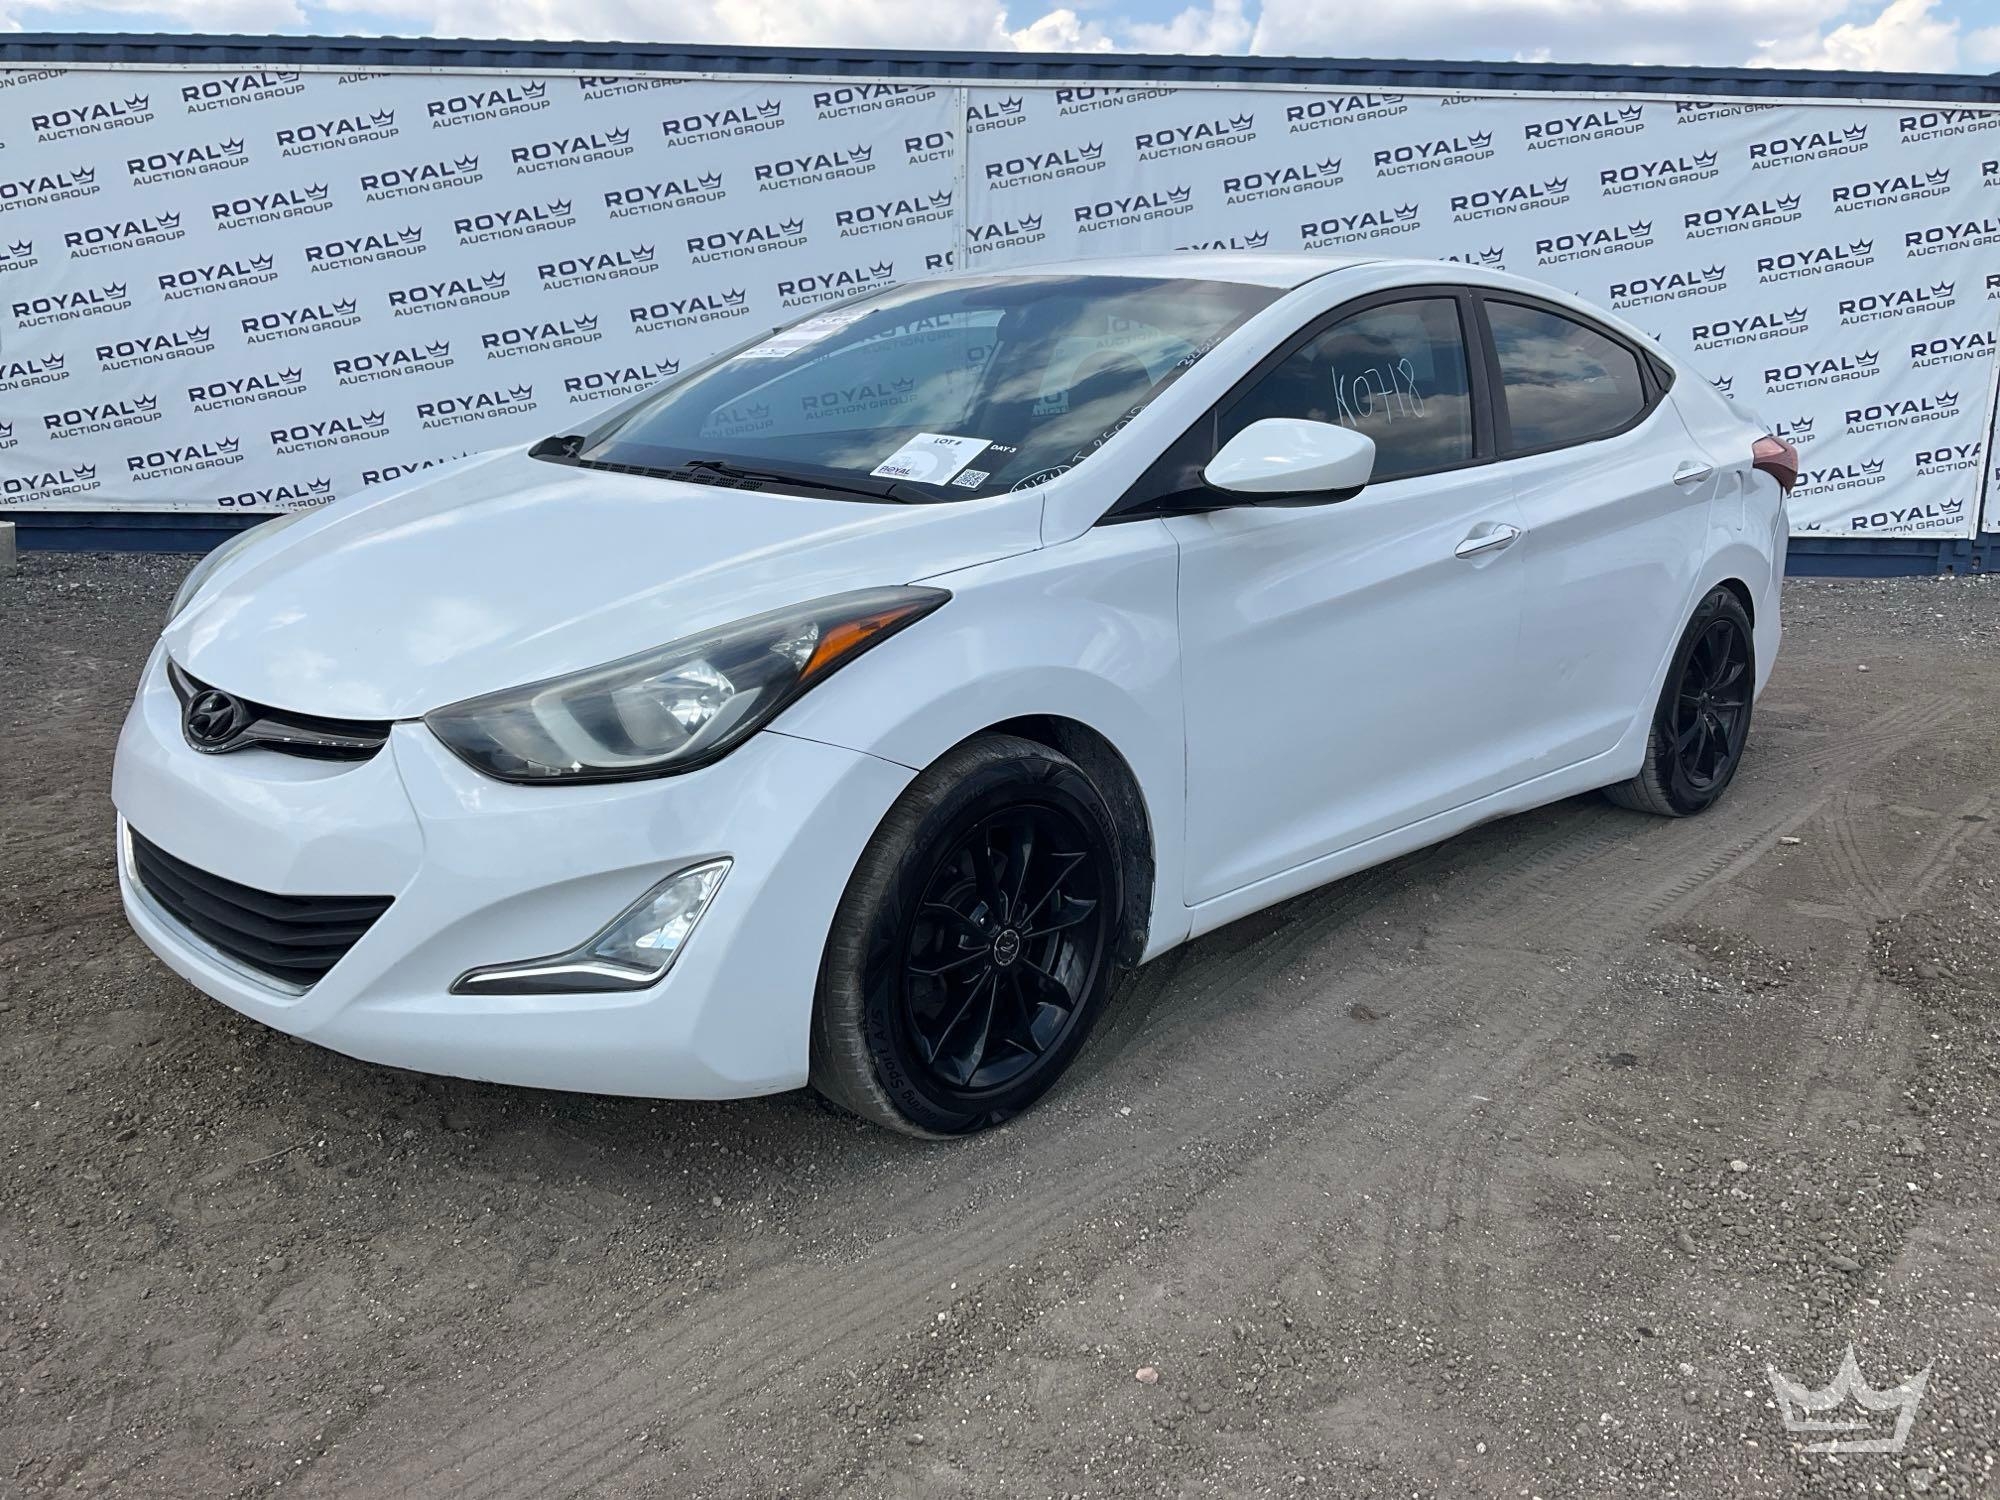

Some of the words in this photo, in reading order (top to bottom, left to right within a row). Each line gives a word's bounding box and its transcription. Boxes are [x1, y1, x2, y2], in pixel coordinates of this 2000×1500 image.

[31, 101, 126, 131] ROYAL
[38, 123, 102, 143] AUCTION
[104, 113, 154, 130] GROUP
[662, 107, 758, 136] ROYAL
[1525, 111, 1619, 140] ROYAL
[276, 116, 372, 146] ROYAL
[282, 137, 346, 157] AUCTION
[348, 128, 399, 144] GROUP
[668, 128, 731, 148] AUCTION
[734, 119, 785, 135] GROUP
[1135, 120, 1230, 150] ROYAL
[1528, 133, 1591, 151] AUCTION
[1594, 124, 1645, 139] GROUP
[1750, 131, 1843, 159] ROYAL
[127, 145, 222, 175] ROYAL
[511, 134, 607, 164] ROYAL
[517, 155, 580, 175] AUCTION
[583, 147, 634, 162] GROUP
[1139, 142, 1203, 162] AUCTION
[1205, 133, 1256, 149] GROUP
[1374, 138, 1468, 166] ROYAL
[1752, 151, 1815, 170] AUCTION
[1817, 143, 1868, 158] GROUP
[133, 166, 196, 186] AUCTION
[198, 157, 249, 173] GROUP
[754, 152, 849, 181] ROYAL
[760, 173, 823, 192] AUCTION
[825, 164, 876, 180] GROUP
[985, 149, 1079, 179] ROYAL
[990, 171, 1053, 190] AUCTION
[1056, 161, 1106, 178] GROUP
[1377, 159, 1441, 178] AUCTION
[1443, 150, 1494, 166] GROUP
[1600, 157, 1693, 186] ROYAL
[604, 179, 699, 208] ROYAL
[1223, 165, 1317, 194] ROYAL
[1227, 186, 1290, 205] AUCTION
[1293, 177, 1343, 193] GROUP
[1603, 178, 1666, 196] AUCTION
[1669, 169, 1719, 185] GROUP
[1833, 174, 1925, 203] ROYAL
[212, 190, 306, 220] ROYAL
[610, 200, 673, 219] AUCTION
[675, 191, 726, 207] GROUP
[836, 198, 930, 226] ROYAL
[1074, 192, 1168, 222] ROYAL
[1451, 184, 1544, 212] ROYAL
[1453, 204, 1517, 223] AUCTION
[1519, 195, 1570, 211] GROUP
[1834, 194, 1898, 213] AUCTION
[1900, 186, 1950, 202] GROUP
[218, 211, 281, 231] AUCTION
[283, 202, 333, 218] GROUP
[454, 206, 549, 234] ROYAL
[840, 219, 903, 238] AUCTION
[1078, 214, 1141, 233] AUCTION
[1144, 204, 1193, 220] GROUP
[1301, 210, 1394, 239] ROYAL
[1684, 201, 1777, 229] ROYAL
[1686, 221, 1749, 239] AUCTION
[1752, 212, 1802, 228] GROUP
[64, 218, 158, 248] ROYAL
[71, 240, 133, 259] AUCTION
[135, 230, 185, 246] GROUP
[460, 227, 523, 246] AUCTION
[525, 218, 576, 234] GROUP
[687, 225, 781, 253] ROYAL
[1304, 231, 1367, 250] AUCTION
[1370, 222, 1420, 238] GROUP
[1536, 227, 1628, 255] ROYAL
[692, 246, 755, 264] AUCTION
[757, 237, 807, 253] GROUP
[1538, 247, 1601, 266] AUCTION
[1604, 239, 1654, 254] GROUP
[1757, 245, 1849, 273] ROYAL
[158, 261, 251, 290] ROYAL
[537, 252, 632, 280] ROYAL
[543, 272, 606, 291] AUCTION
[609, 264, 659, 279] GROUP
[1759, 266, 1822, 284] AUCTION
[1824, 257, 1874, 272] GROUP
[164, 281, 226, 301] AUCTION
[228, 272, 278, 288] GROUP
[389, 278, 483, 307] ROYAL
[1610, 271, 1702, 299] ROYAL
[1612, 292, 1675, 310] AUCTION
[1677, 283, 1727, 298] GROUP
[12, 289, 105, 318] ROYAL
[19, 310, 80, 329] AUCTION
[82, 301, 131, 316] GROUP
[394, 298, 457, 317] AUCTION
[459, 290, 510, 306] GROUP
[630, 295, 723, 323] ROYAL
[1839, 288, 1931, 315] ROYAL
[1841, 308, 1903, 325] AUCTION
[1906, 299, 1955, 314] GROUP
[241, 305, 334, 333] ROYAL
[247, 325, 309, 344] AUCTION
[311, 316, 361, 332] GROUP
[635, 315, 697, 334] AUCTION
[700, 307, 749, 322] GROUP
[1692, 313, 1784, 341] ROYAL
[96, 333, 188, 361] ROYAL
[481, 321, 575, 349] ROYAL
[487, 341, 550, 360] AUCTION
[552, 333, 602, 348] GROUP
[1694, 333, 1756, 351] AUCTION
[1759, 325, 1808, 340] GROUP
[102, 353, 164, 372] AUCTION
[165, 344, 215, 360] GROUP
[333, 347, 427, 375] ROYAL
[1764, 357, 1856, 384] ROYAL
[1912, 351, 1974, 369] AUCTION
[339, 368, 402, 386] AUCTION
[404, 359, 454, 374] GROUP
[1766, 377, 1828, 394] AUCTION
[1831, 368, 1880, 383] GROUP
[417, 391, 510, 419] ROYAL
[802, 383, 891, 410] ROYAL
[43, 401, 136, 429] ROYAL
[422, 411, 485, 429] AUCTION
[487, 403, 537, 418] GROUP
[805, 402, 867, 420] AUCTION
[1845, 397, 1935, 425] ROYAL
[1846, 417, 1908, 435] AUCTION
[1910, 409, 1960, 424] GROUP
[50, 421, 111, 440] AUCTION
[113, 412, 162, 428] GROUP
[270, 417, 363, 445] ROYAL
[276, 437, 338, 455] AUCTION
[340, 428, 389, 444] GROUP
[990, 444, 1007, 452] DAY
[127, 444, 218, 471] ROYAL
[133, 464, 193, 482] AUCTION
[195, 455, 244, 470] GROUP
[879, 465, 911, 475] ROYAL
[52, 481, 101, 496] GROUP
[1852, 505, 1940, 530] ROYAL
[1915, 515, 1964, 530] GROUP
[879, 1048, 904, 1089] Sport
